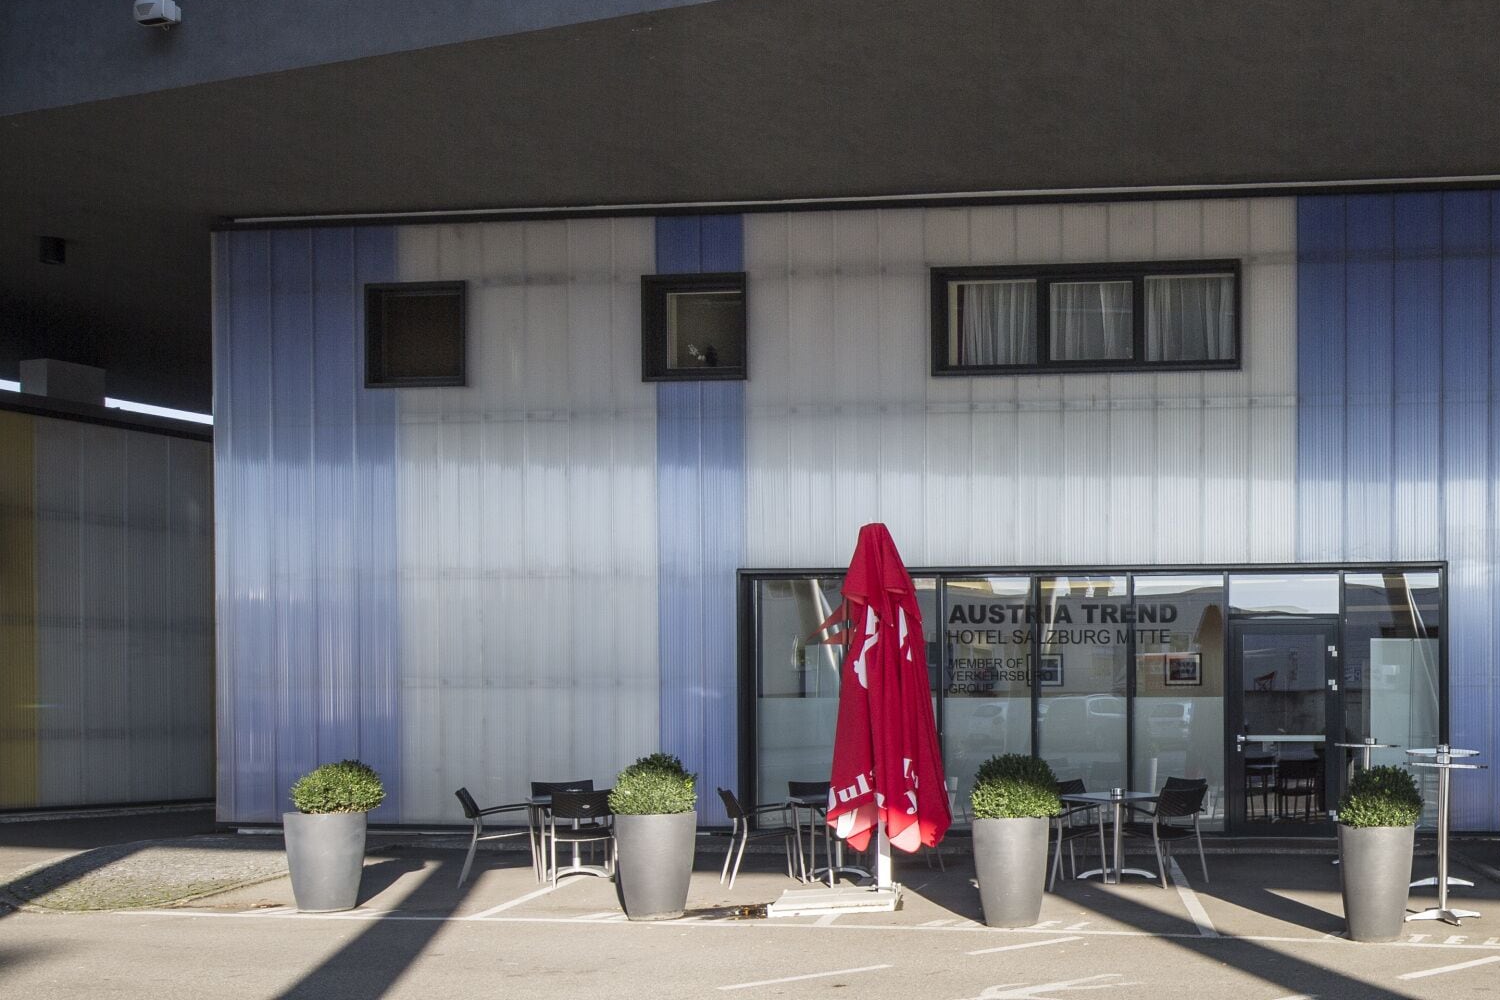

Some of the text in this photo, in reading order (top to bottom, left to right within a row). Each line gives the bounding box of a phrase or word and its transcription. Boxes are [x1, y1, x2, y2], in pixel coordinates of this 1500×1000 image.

[948, 604, 1178, 625] AUSTRIA TREND
[948, 629, 1171, 645] HOTEL SALZBURG MITTE
[948, 658, 1024, 669] MEMBER OF
[948, 683, 994, 694] GROUP
